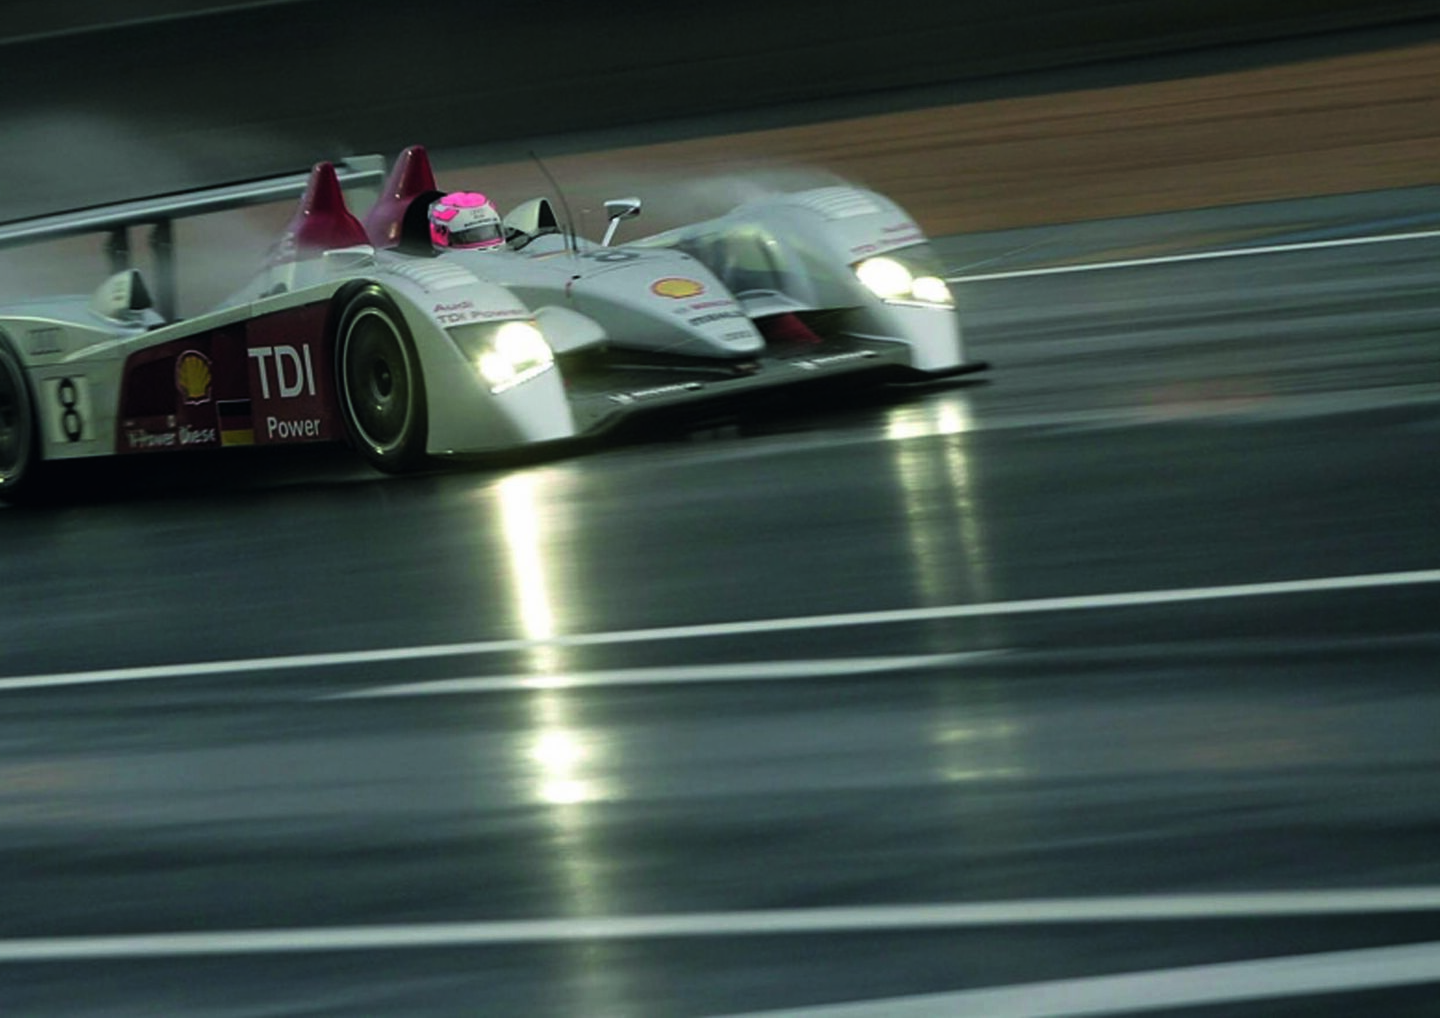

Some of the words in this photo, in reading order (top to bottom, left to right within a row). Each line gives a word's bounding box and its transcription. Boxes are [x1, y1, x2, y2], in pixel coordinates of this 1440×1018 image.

[433, 300, 474, 313] Audi
[436, 312, 466, 324] TDI
[247, 343, 316, 400] TDI
[57, 377, 83, 442] 8
[266, 416, 321, 439] Power
